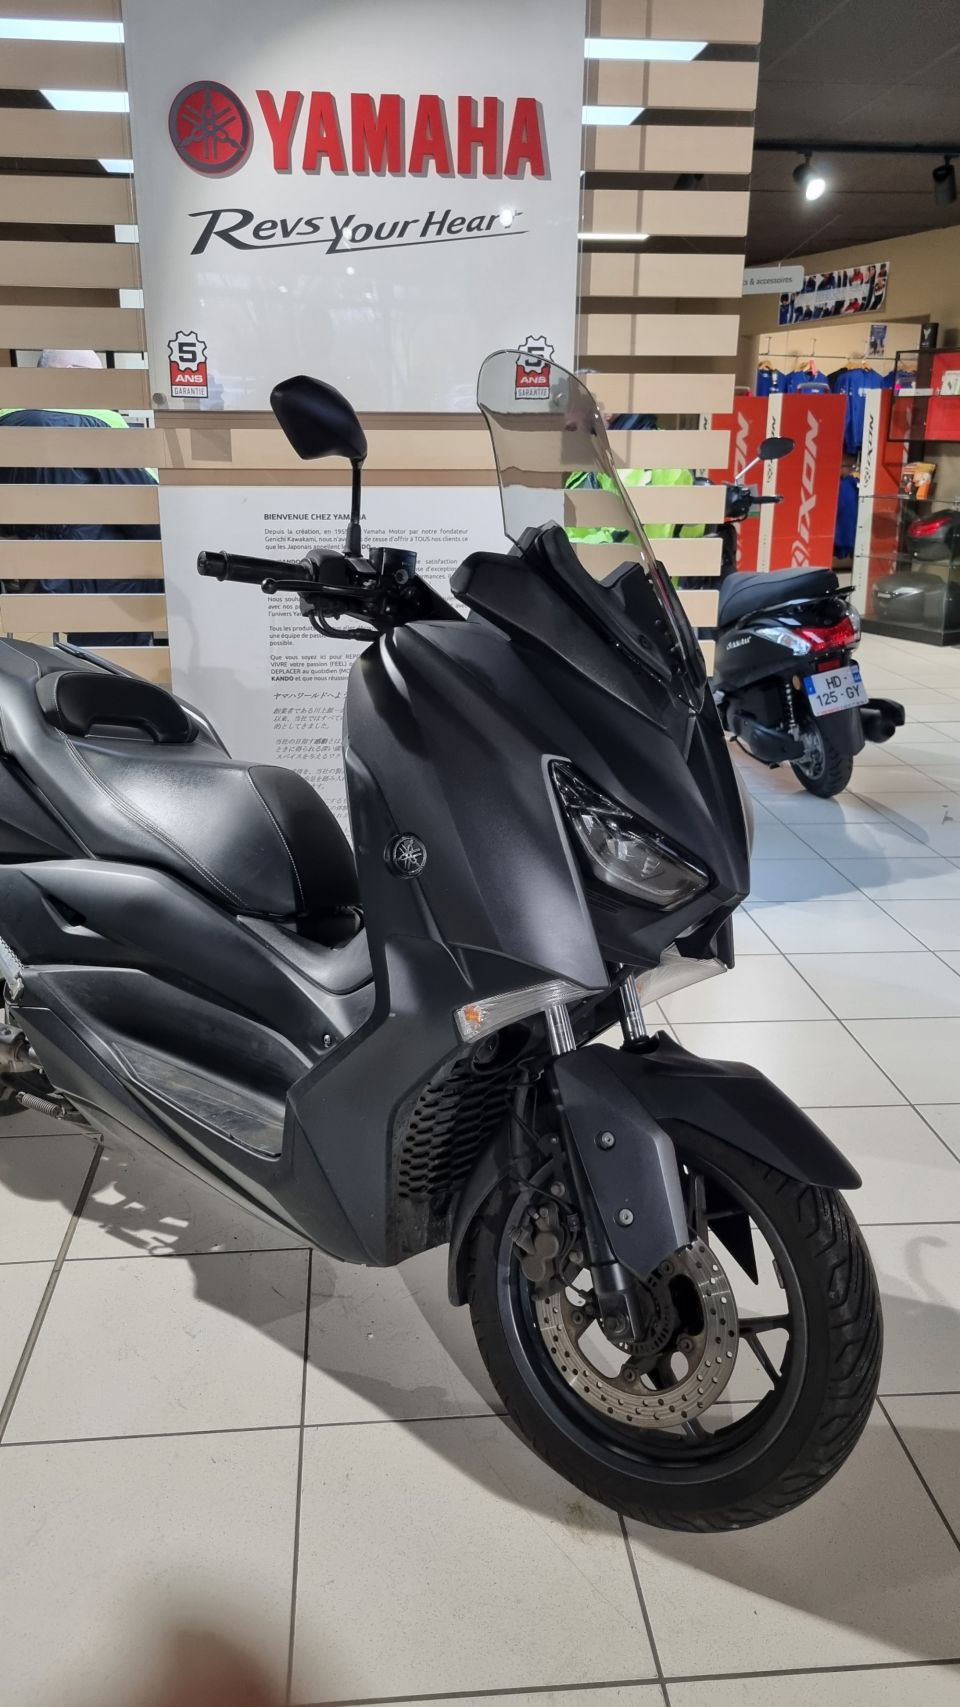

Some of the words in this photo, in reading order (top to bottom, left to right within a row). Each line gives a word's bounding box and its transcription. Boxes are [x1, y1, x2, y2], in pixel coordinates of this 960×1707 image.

[255, 89, 549, 179] YAMAHA
[188, 208, 325, 255] Revs
[325, 213, 420, 255] Your
[756, 277, 793, 285] accessoires
[178, 342, 197, 363] 5
[525, 346, 545, 367] 5
[175, 374, 203, 383] ANS
[520, 376, 547, 384] ANS
[174, 387, 206, 396] GARANTIE
[517, 388, 548, 397] GARANTIE
[797, 409, 819, 544] IXON
[264, 513, 310, 521] BIENVENUE
[310, 513, 332, 521] CHEZ
[333, 513, 367, 521] YAMA
[264, 528, 285, 536] Depuis
[408, 529, 419, 537] par
